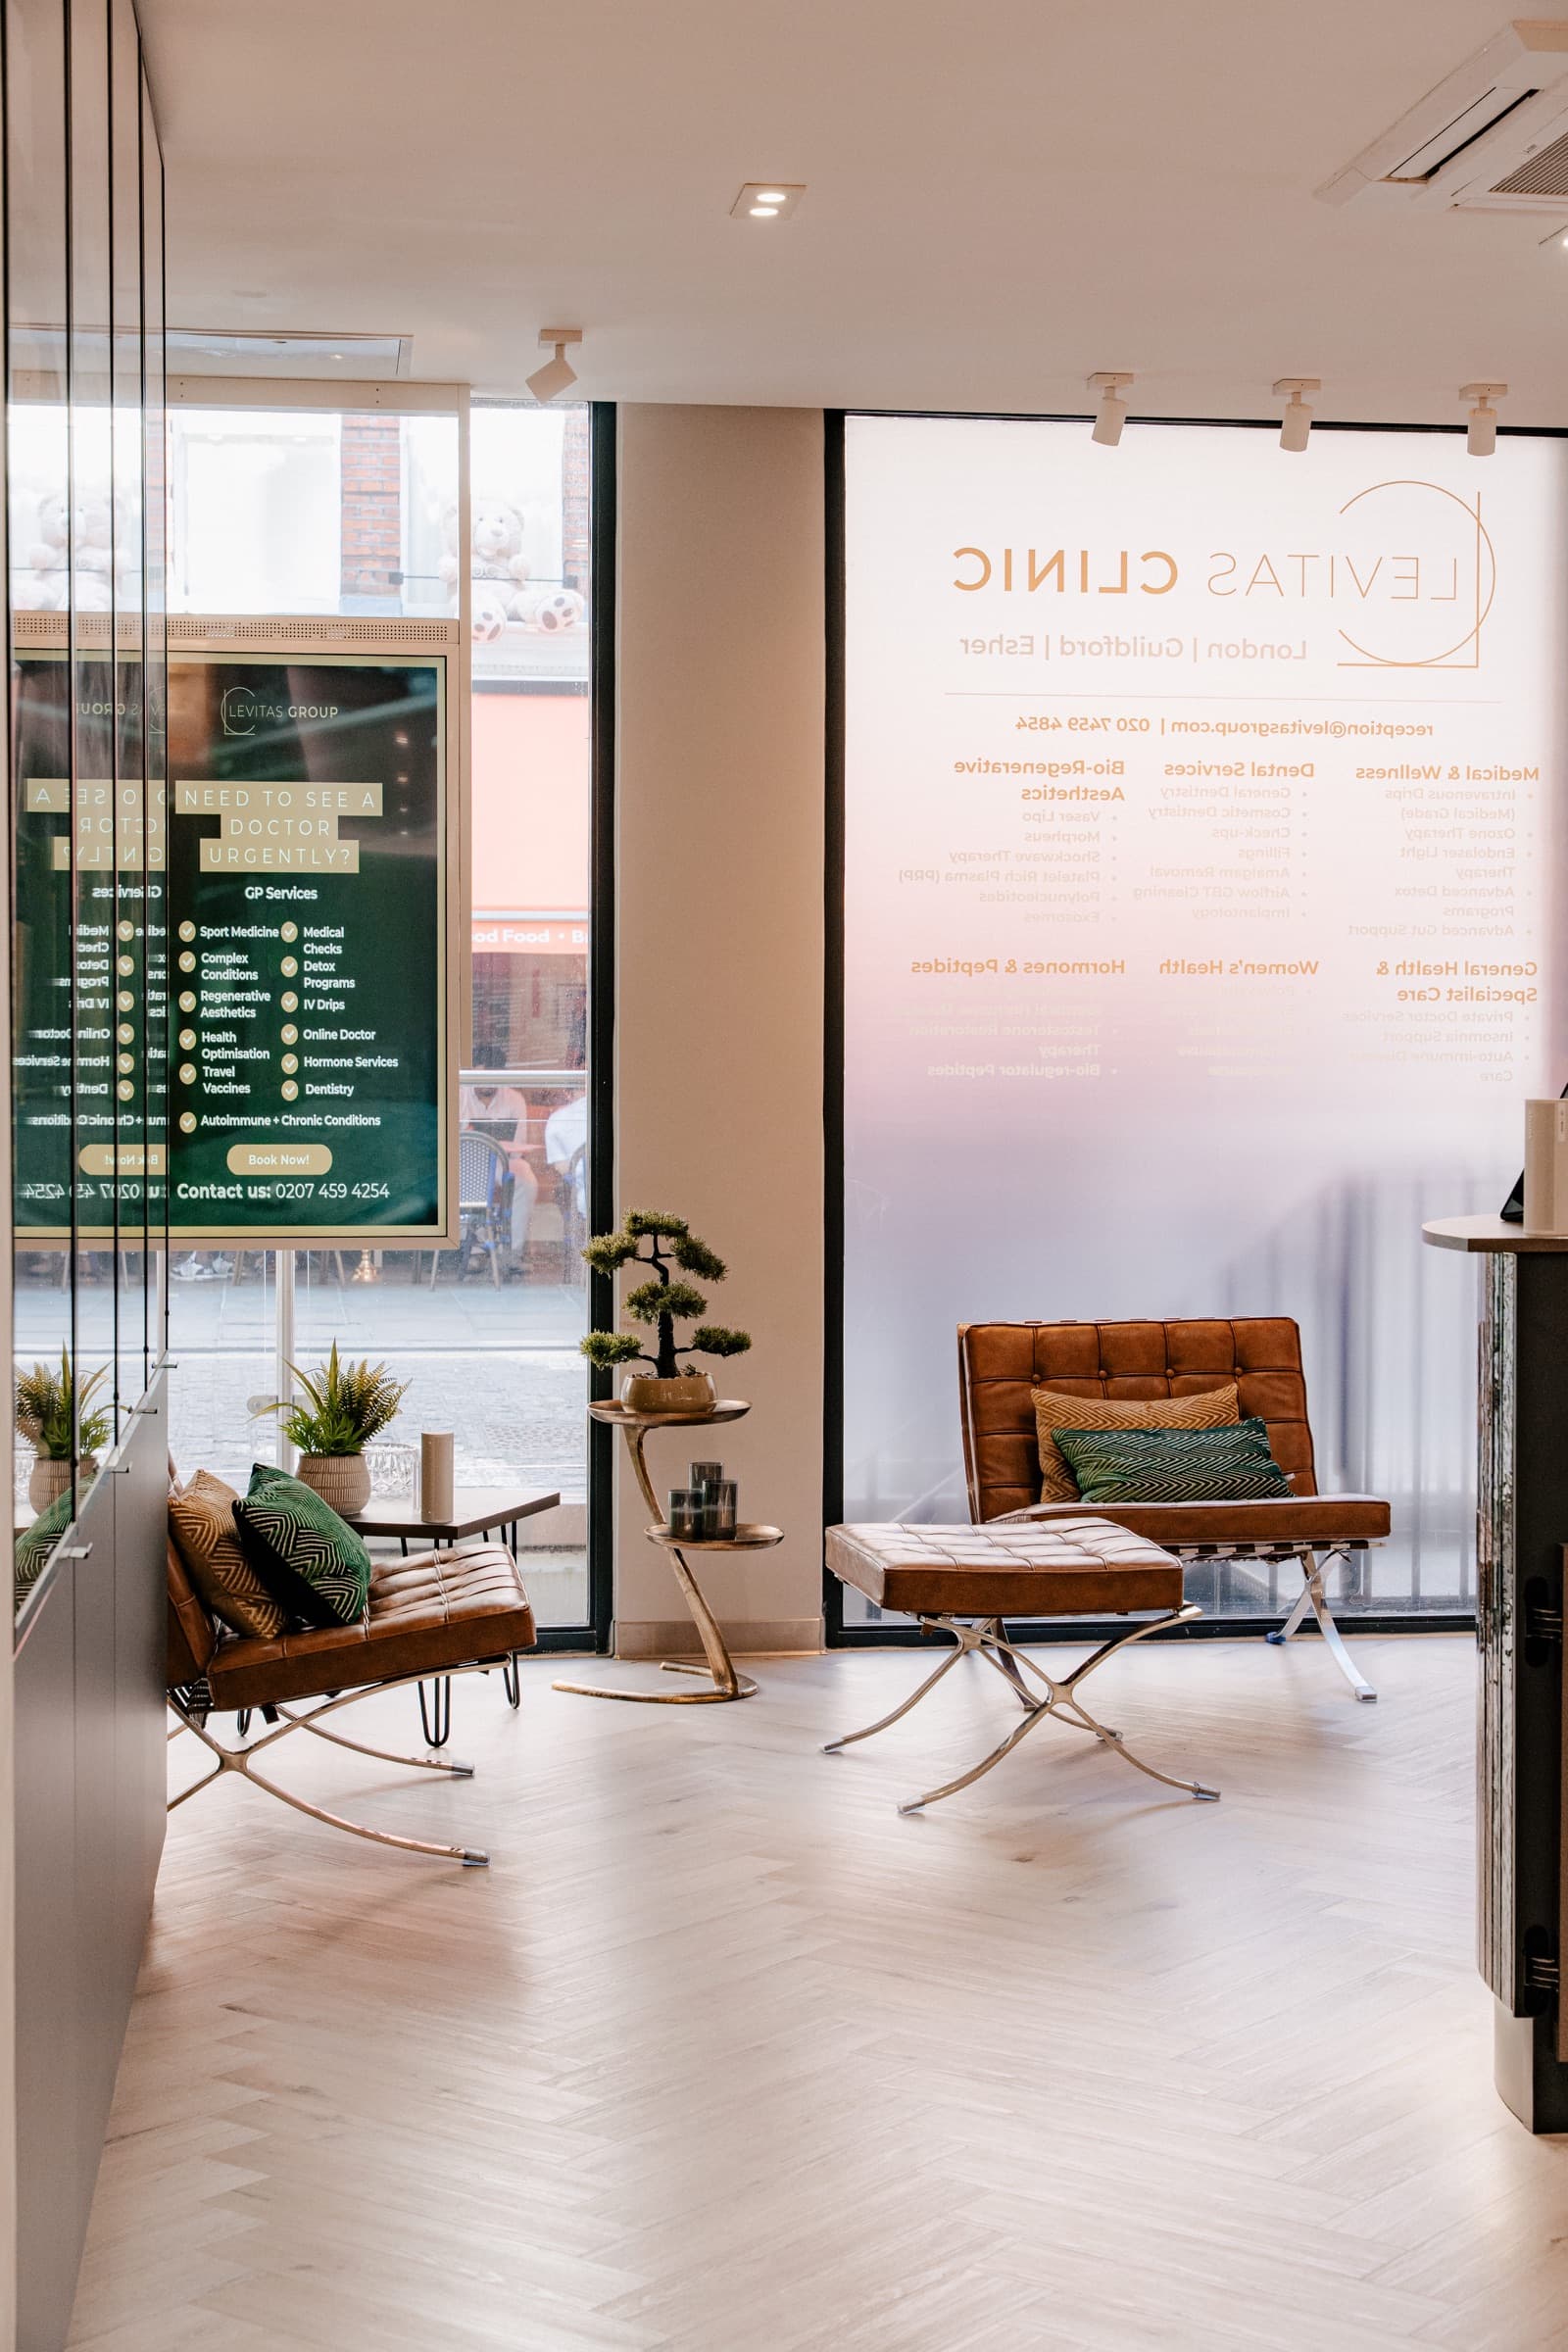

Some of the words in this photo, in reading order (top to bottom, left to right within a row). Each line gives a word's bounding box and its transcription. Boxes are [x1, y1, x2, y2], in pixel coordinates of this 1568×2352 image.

[229, 705, 283, 717] LEVITAS
[288, 706, 338, 718] GROUP
[185, 790, 250, 806] NEED
[262, 791, 291, 807] TO
[306, 792, 348, 808] SEE
[362, 792, 374, 808] A
[230, 819, 329, 836] DOCTOR
[210, 847, 350, 864] URGENTLY?
[245, 887, 264, 900] GP
[266, 886, 318, 900] Services
[200, 926, 229, 939] Sport
[231, 926, 279, 938] Medicine
[303, 927, 344, 938] Medical
[503, 928, 550, 943] Food
[303, 944, 342, 955] Checks
[201, 953, 249, 965] Complex
[304, 961, 335, 971] Detox
[201, 969, 259, 980] Conditions
[304, 978, 356, 990] Programs
[201, 991, 270, 1003] Regenerative
[304, 1000, 316, 1009] IV
[318, 999, 345, 1011] Drips
[201, 1006, 256, 1018] Aesthetics
[202, 1031, 236, 1043] Health
[303, 1029, 338, 1041] Online
[340, 1029, 376, 1041] Doctor
[202, 1048, 270, 1061] Optimisation
[304, 1056, 354, 1067] Hormone
[356, 1056, 399, 1067] Services
[203, 1066, 235, 1077] Travel
[203, 1082, 251, 1094] Vaccines
[305, 1083, 354, 1098] Dentistry
[281, 1115, 322, 1126] Chronic
[324, 1115, 380, 1126] Conditions
[249, 1154, 277, 1165] Book
[280, 1154, 310, 1165] Now!
[177, 1184, 243, 1200] Contact
[248, 1186, 271, 1199] us:
[275, 1184, 314, 1199] 0207
[318, 1184, 347, 1199] 459
[352, 1184, 390, 1199] 4254
